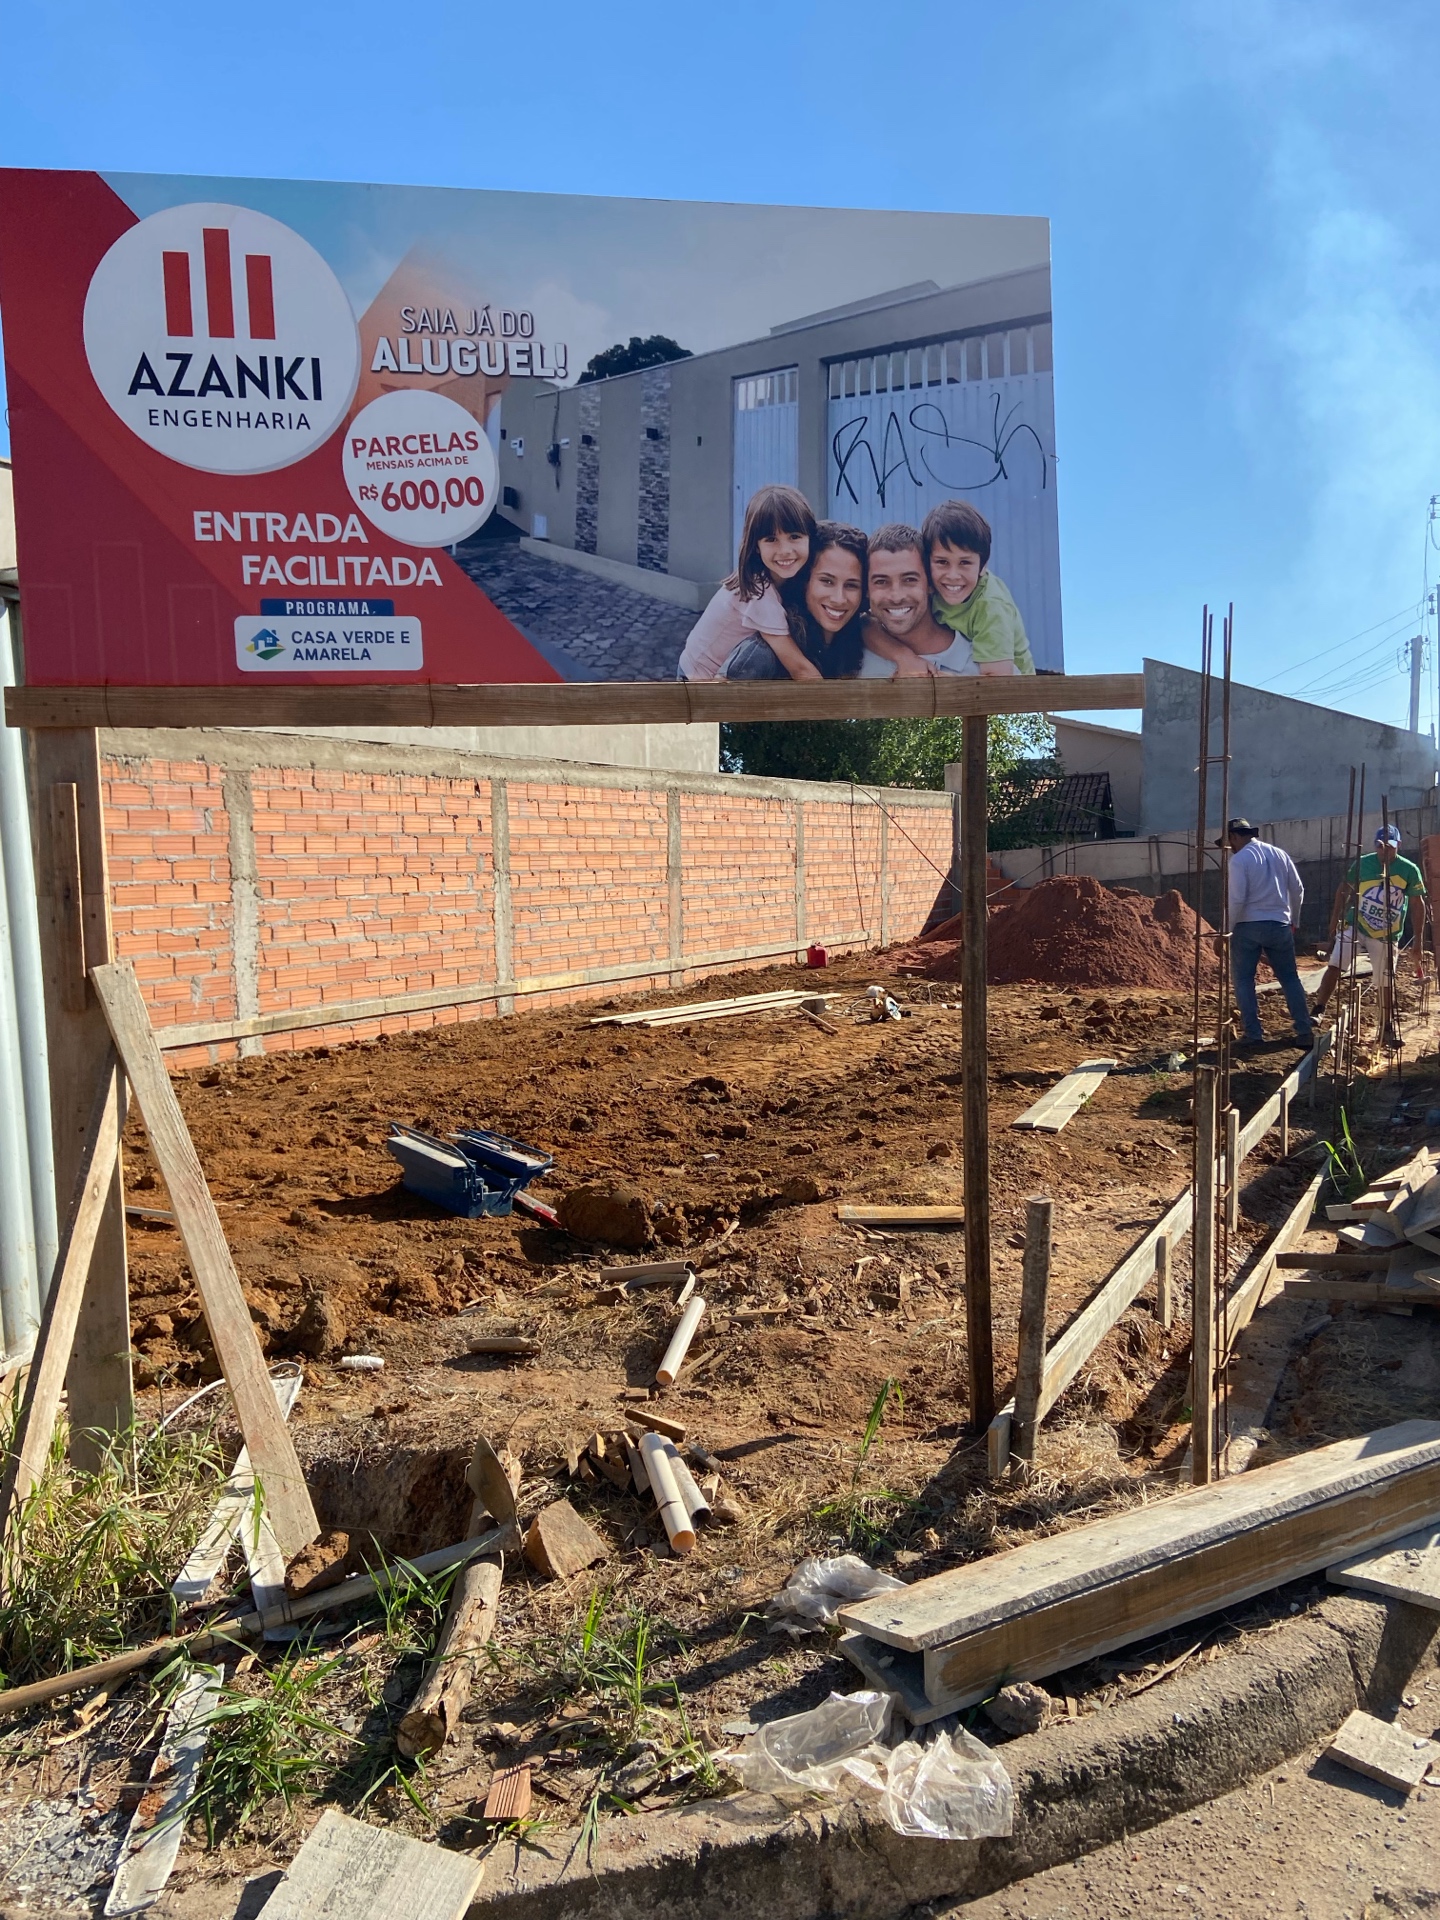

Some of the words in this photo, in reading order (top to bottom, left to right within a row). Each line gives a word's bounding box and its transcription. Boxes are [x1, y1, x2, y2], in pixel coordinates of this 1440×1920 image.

[401, 306, 458, 335] SAIA
[464, 304, 495, 336] JÁ
[500, 310, 534, 338] DO
[370, 336, 568, 378] ALUGUEL!
[127, 351, 322, 401] AZANKI
[148, 409, 311, 430] ENGENHARIA
[351, 430, 479, 459] PARCELAS
[366, 459, 415, 471] MENSAIS
[417, 457, 453, 468] ACIMA
[454, 456, 469, 465] DE
[193, 511, 368, 543] ENTRADA
[241, 555, 443, 587] FACILITADA
[286, 601, 369, 615] PROGRAMA
[291, 630, 338, 644] CASA
[342, 630, 395, 644] VERDE
[401, 631, 410, 644] E
[292, 648, 372, 661] AMARELA
